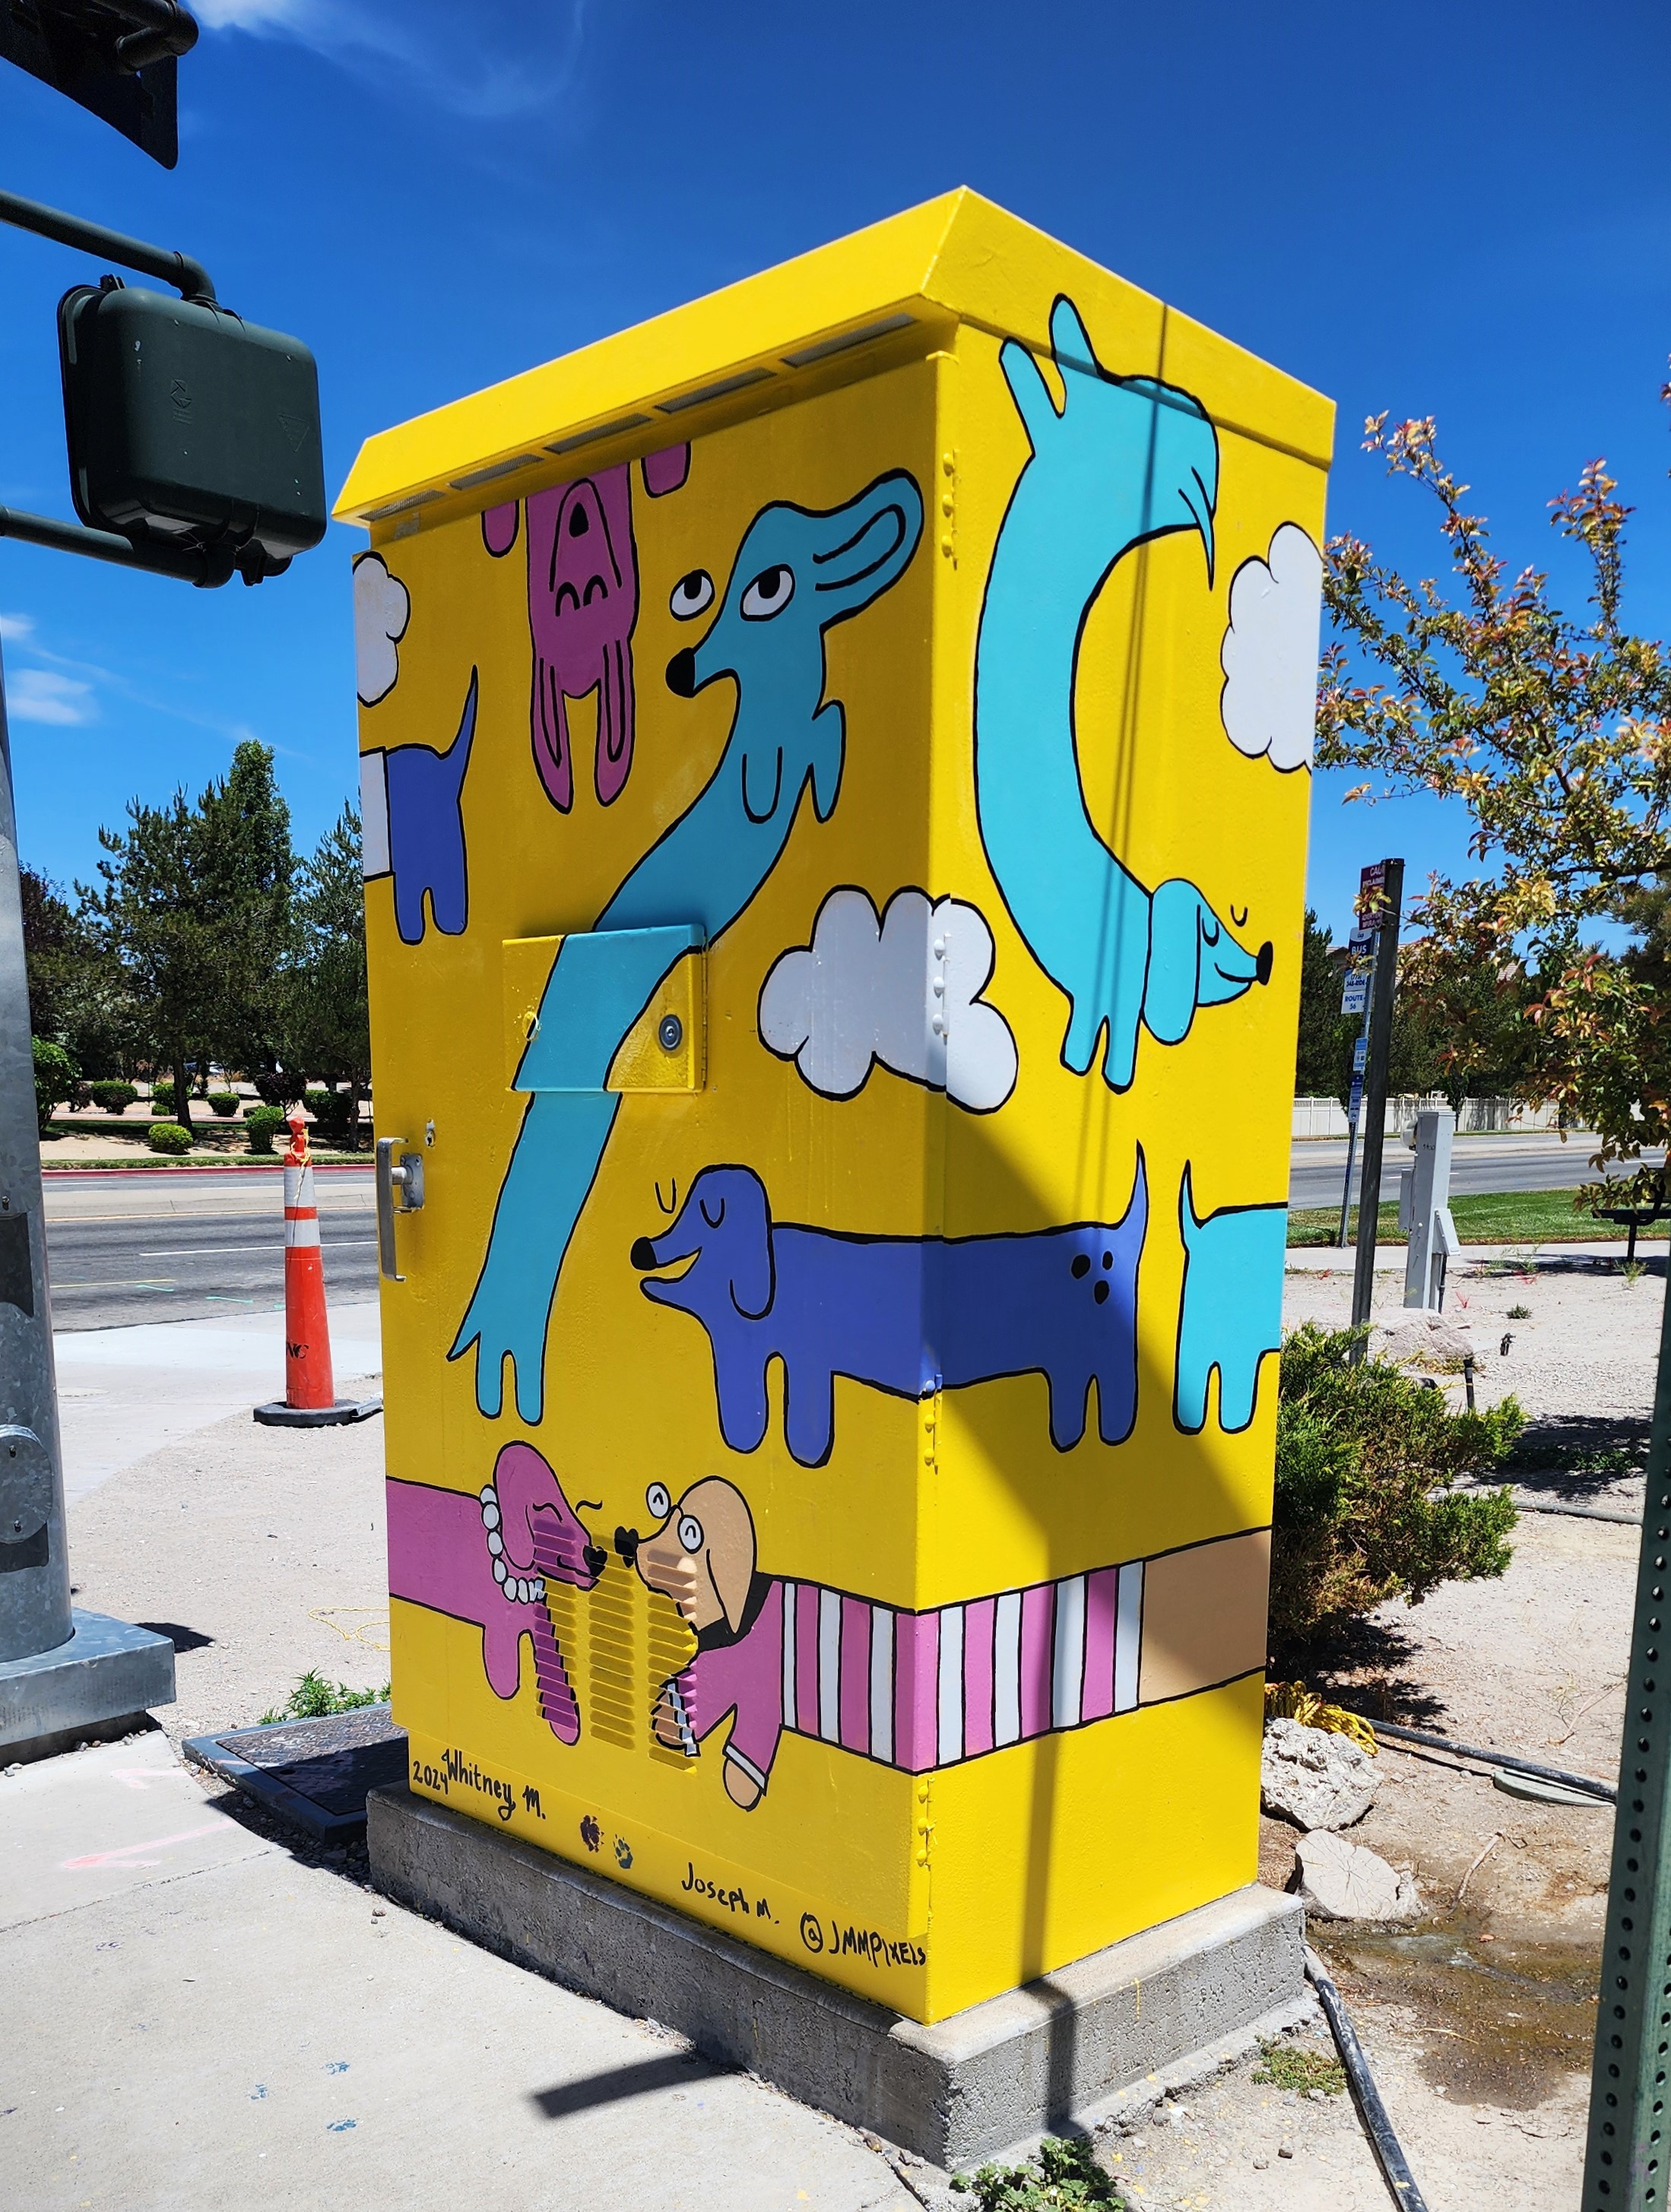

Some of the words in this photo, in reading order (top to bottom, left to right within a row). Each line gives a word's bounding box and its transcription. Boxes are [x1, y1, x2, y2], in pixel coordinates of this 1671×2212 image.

[1352, 945, 1367, 955] BUS
[413, 1760, 449, 1795] 2024
[441, 1748, 516, 1821] Whitney
[522, 1785, 546, 1820] M.
[756, 1898, 780, 1925] M.
